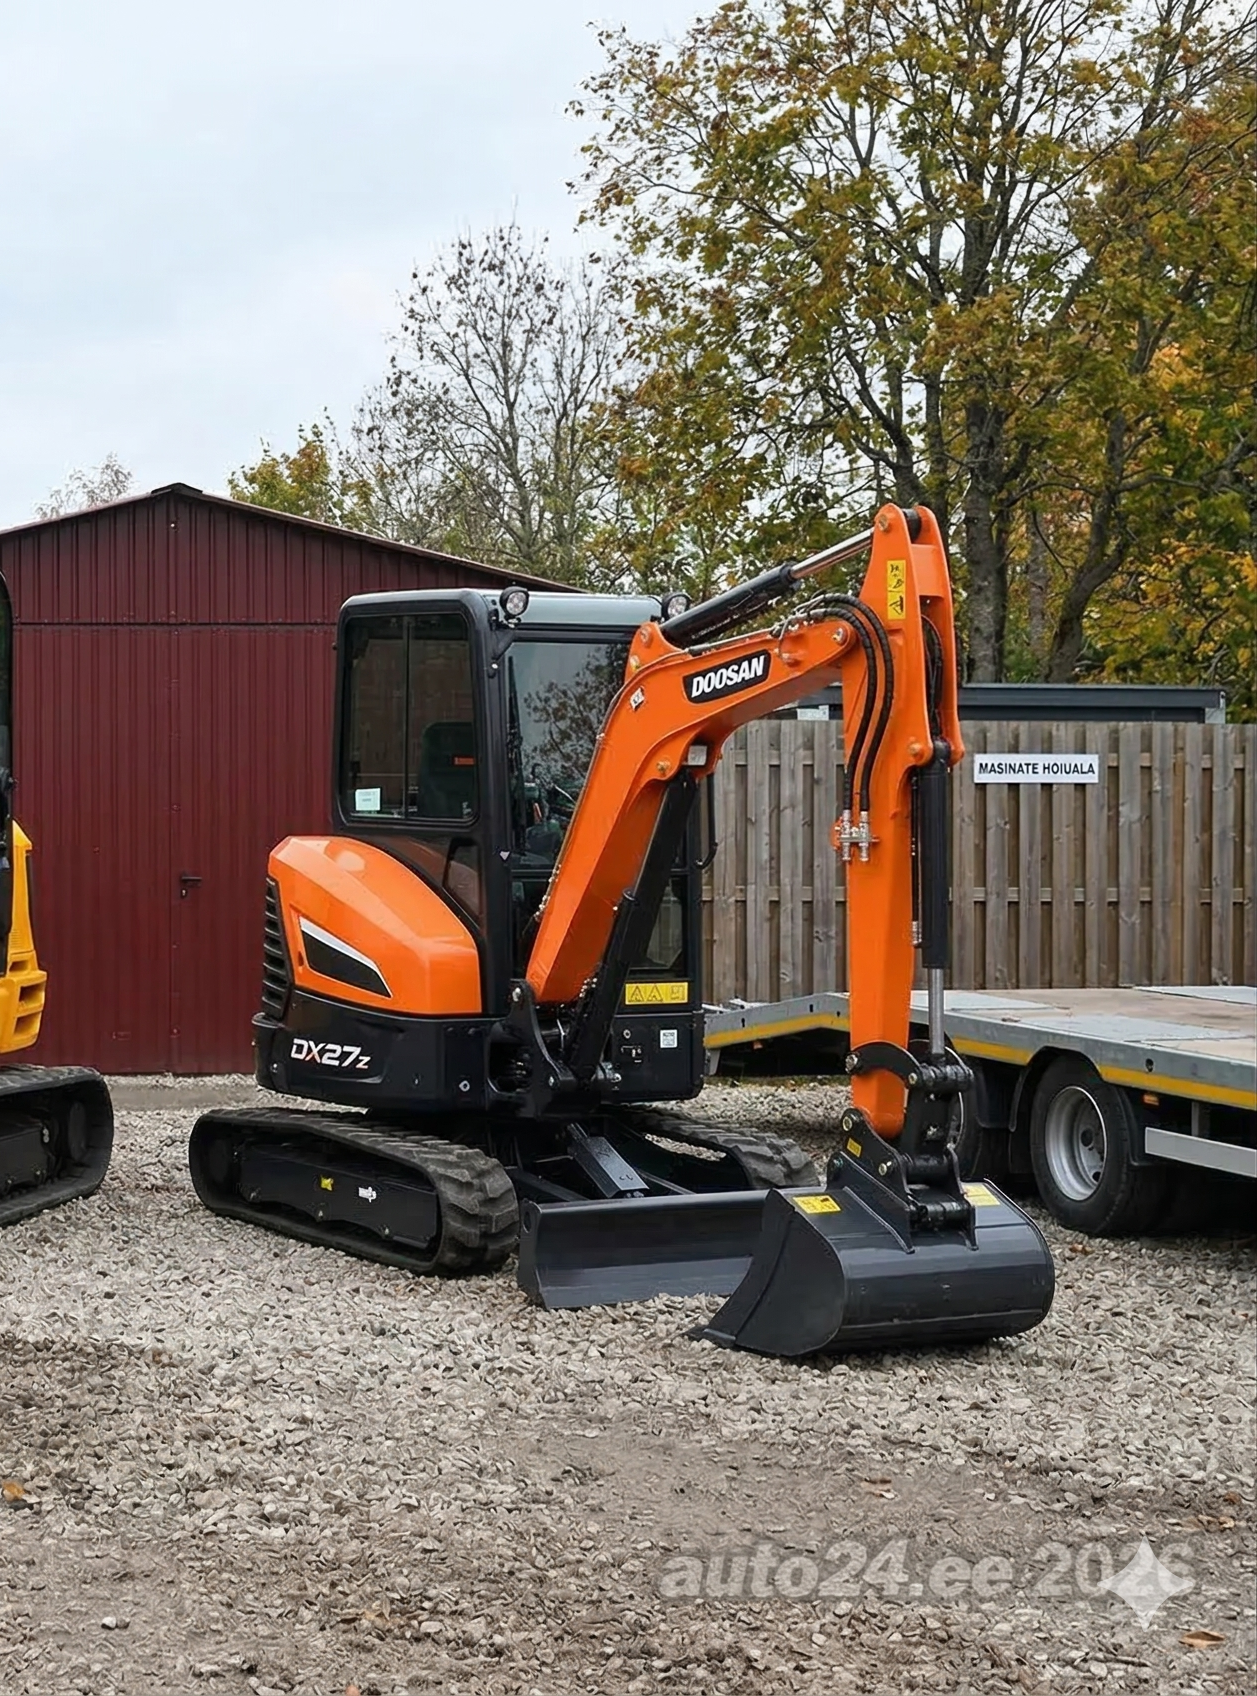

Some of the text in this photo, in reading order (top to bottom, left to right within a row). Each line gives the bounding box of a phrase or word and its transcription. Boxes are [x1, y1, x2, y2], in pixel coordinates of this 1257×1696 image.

[691, 655, 765, 698] DOOSAN
[978, 762, 1096, 775] MASINATE HOIUALA
